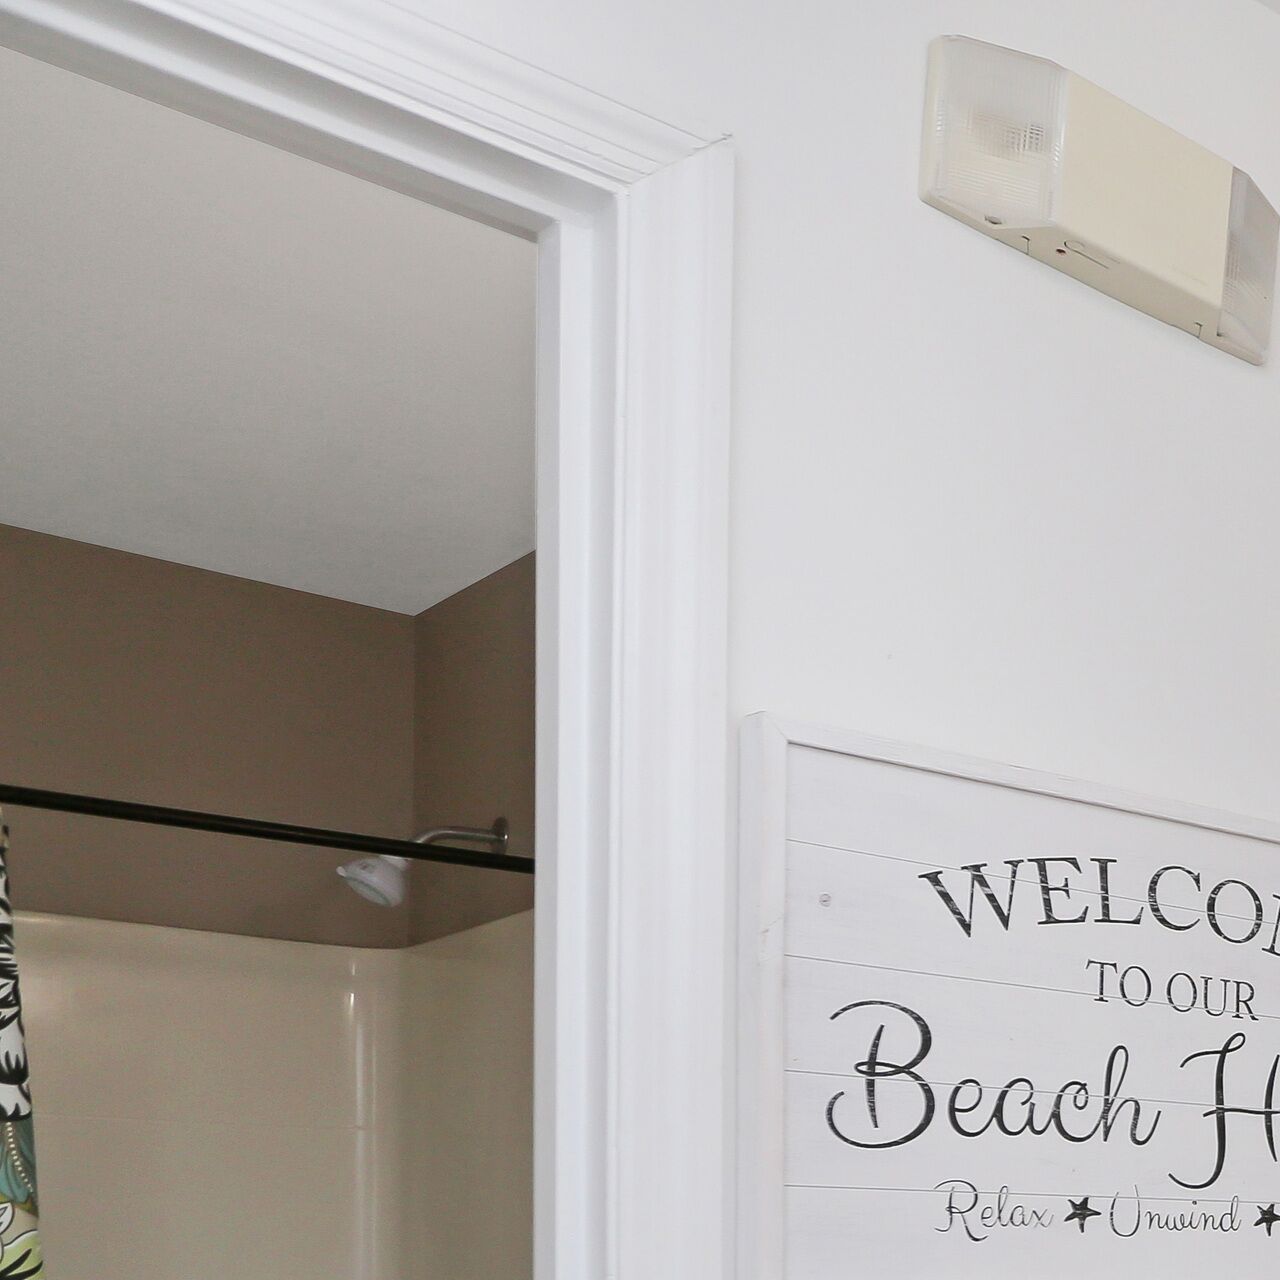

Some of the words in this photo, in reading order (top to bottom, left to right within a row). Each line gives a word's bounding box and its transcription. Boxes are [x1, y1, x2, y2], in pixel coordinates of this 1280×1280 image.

[1086, 958, 1152, 1007] TO
[1166, 971, 1260, 1022] OUR
[825, 1000, 1161, 1149] Beach
[934, 1179, 1054, 1241] Relax
[1110, 1184, 1242, 1238] Unwind
